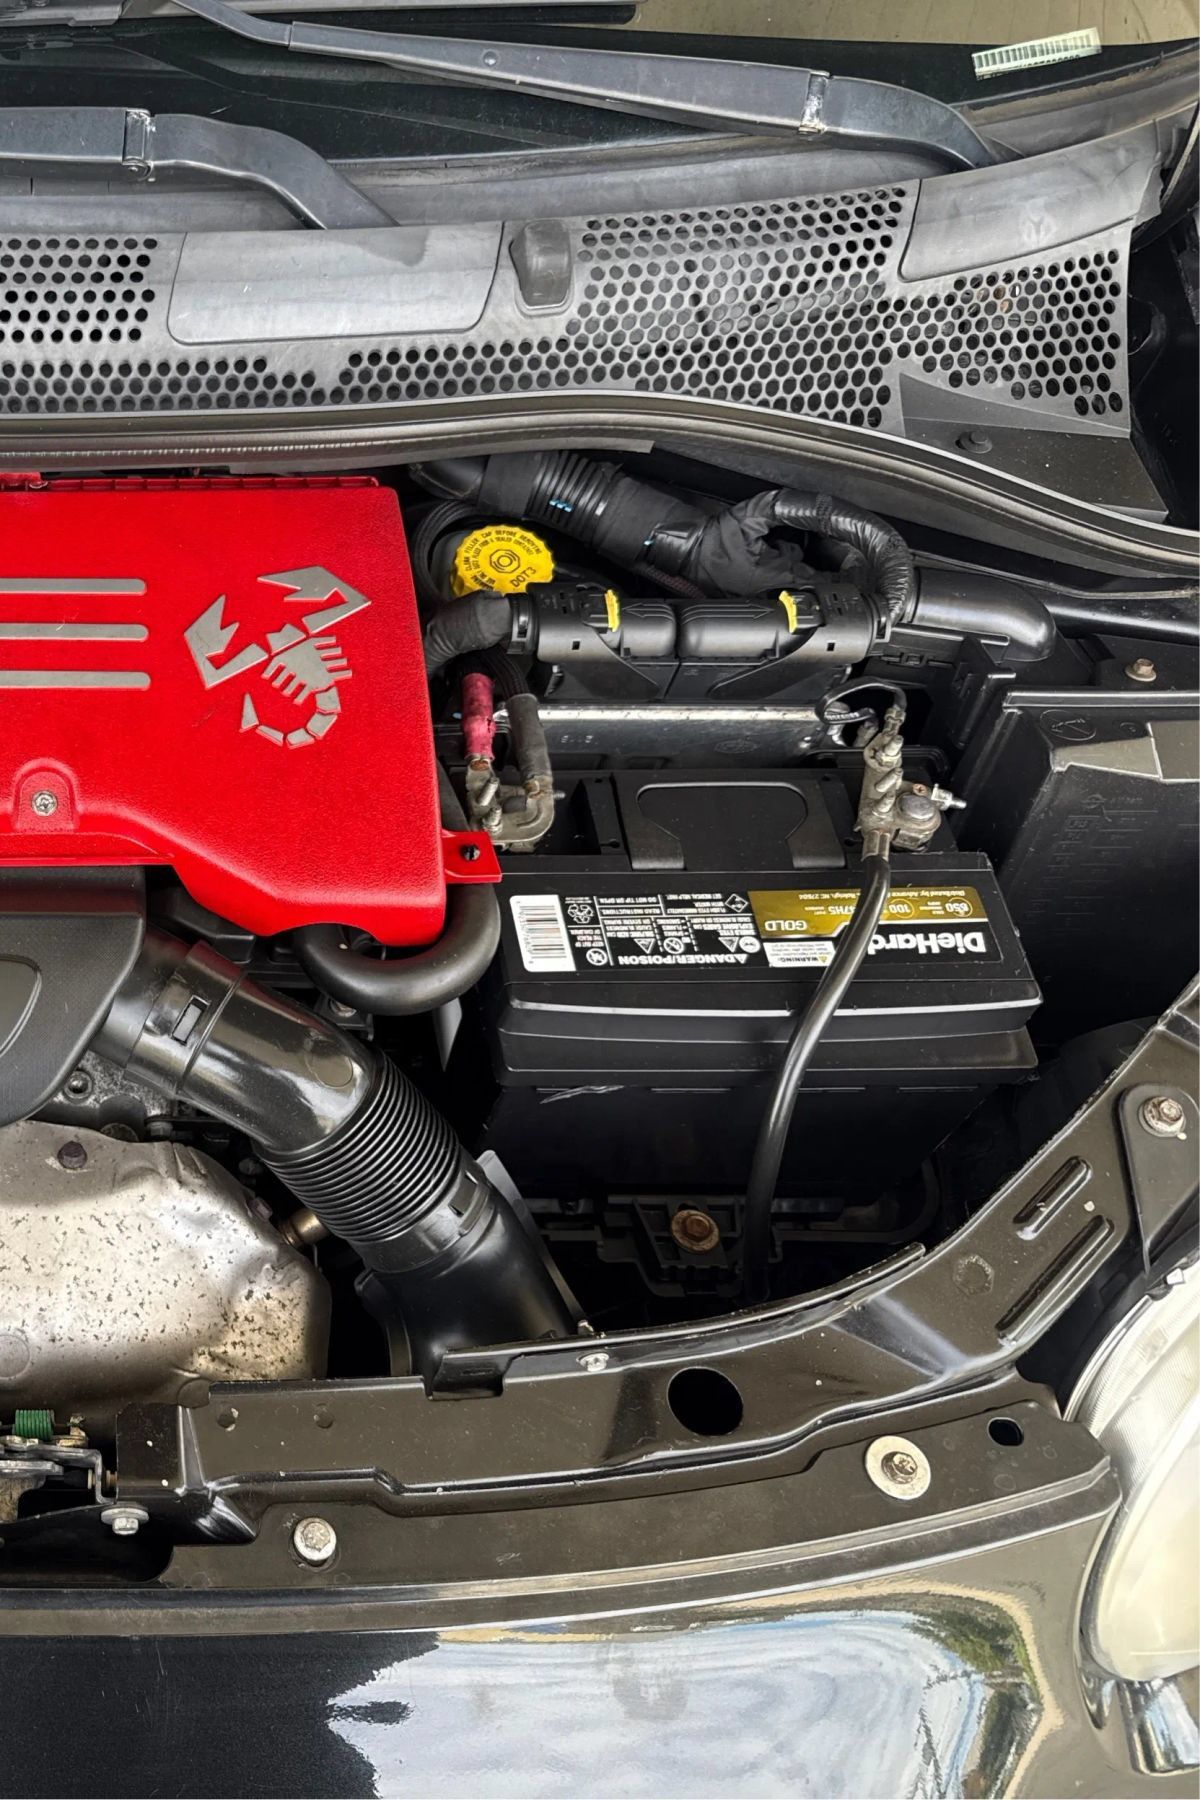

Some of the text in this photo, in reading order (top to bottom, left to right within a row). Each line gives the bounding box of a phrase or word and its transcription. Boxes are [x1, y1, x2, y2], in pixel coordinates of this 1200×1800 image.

[889, 904, 911, 913] 100
[765, 920, 807, 931] GOLD
[867, 932, 986, 955] DieHard
[618, 954, 737, 965] DANGER/POISON
